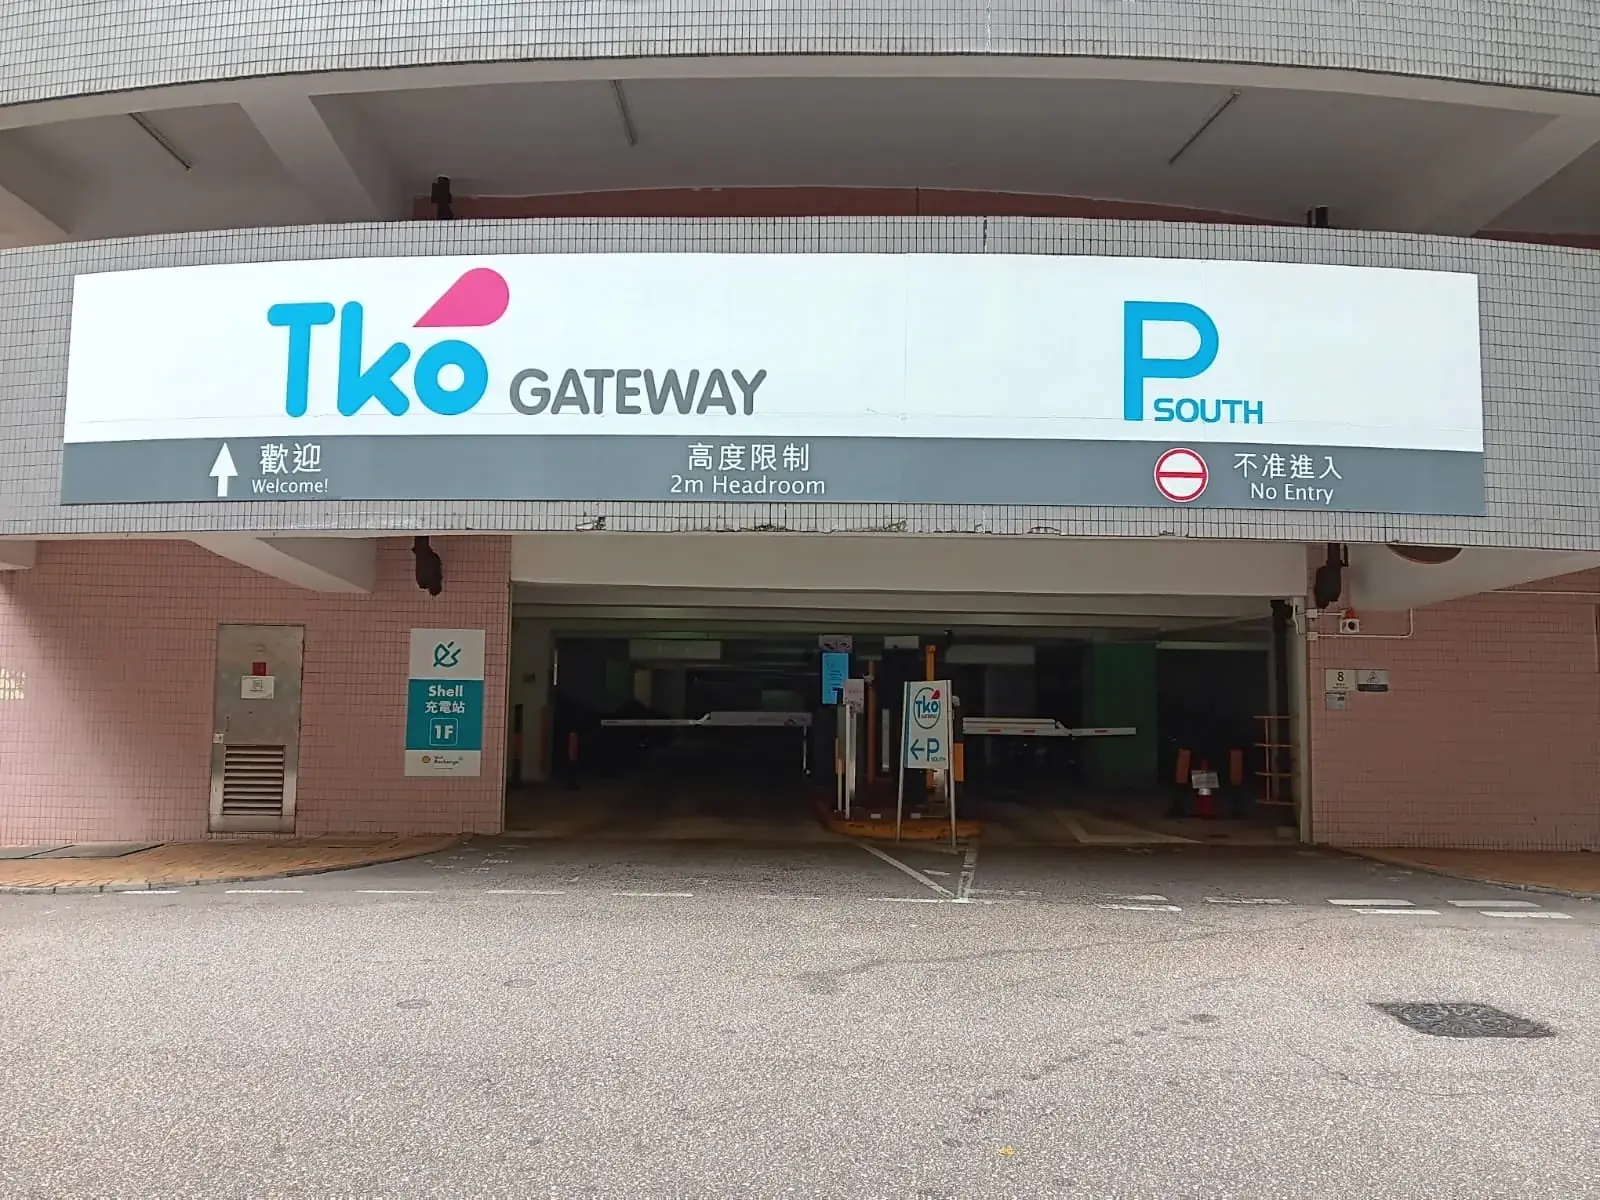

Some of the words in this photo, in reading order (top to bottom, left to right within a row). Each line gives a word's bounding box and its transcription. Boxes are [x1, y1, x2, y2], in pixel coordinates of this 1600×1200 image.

[267, 300, 489, 418] Tko
[509, 368, 767, 416] GATEWAY
[1124, 300, 1219, 421] P
[1153, 397, 1264, 424] SOUTH
[259, 443, 322, 475] 歡迎
[687, 442, 810, 472] 高度限制
[1233, 453, 1343, 480] 不准進入
[251, 478, 329, 494] Welcome!
[670, 474, 704, 494] 2m
[713, 475, 825, 495] Headroom
[1251, 482, 1278, 500] No
[1284, 483, 1334, 505] Entry
[1337, 671, 1345, 682] 8
[428, 684, 463, 697] Shell
[425, 700, 465, 713] 充電站
[915, 695, 939, 718] Tko
[435, 724, 454, 739] 1F
[926, 738, 939, 761] P
